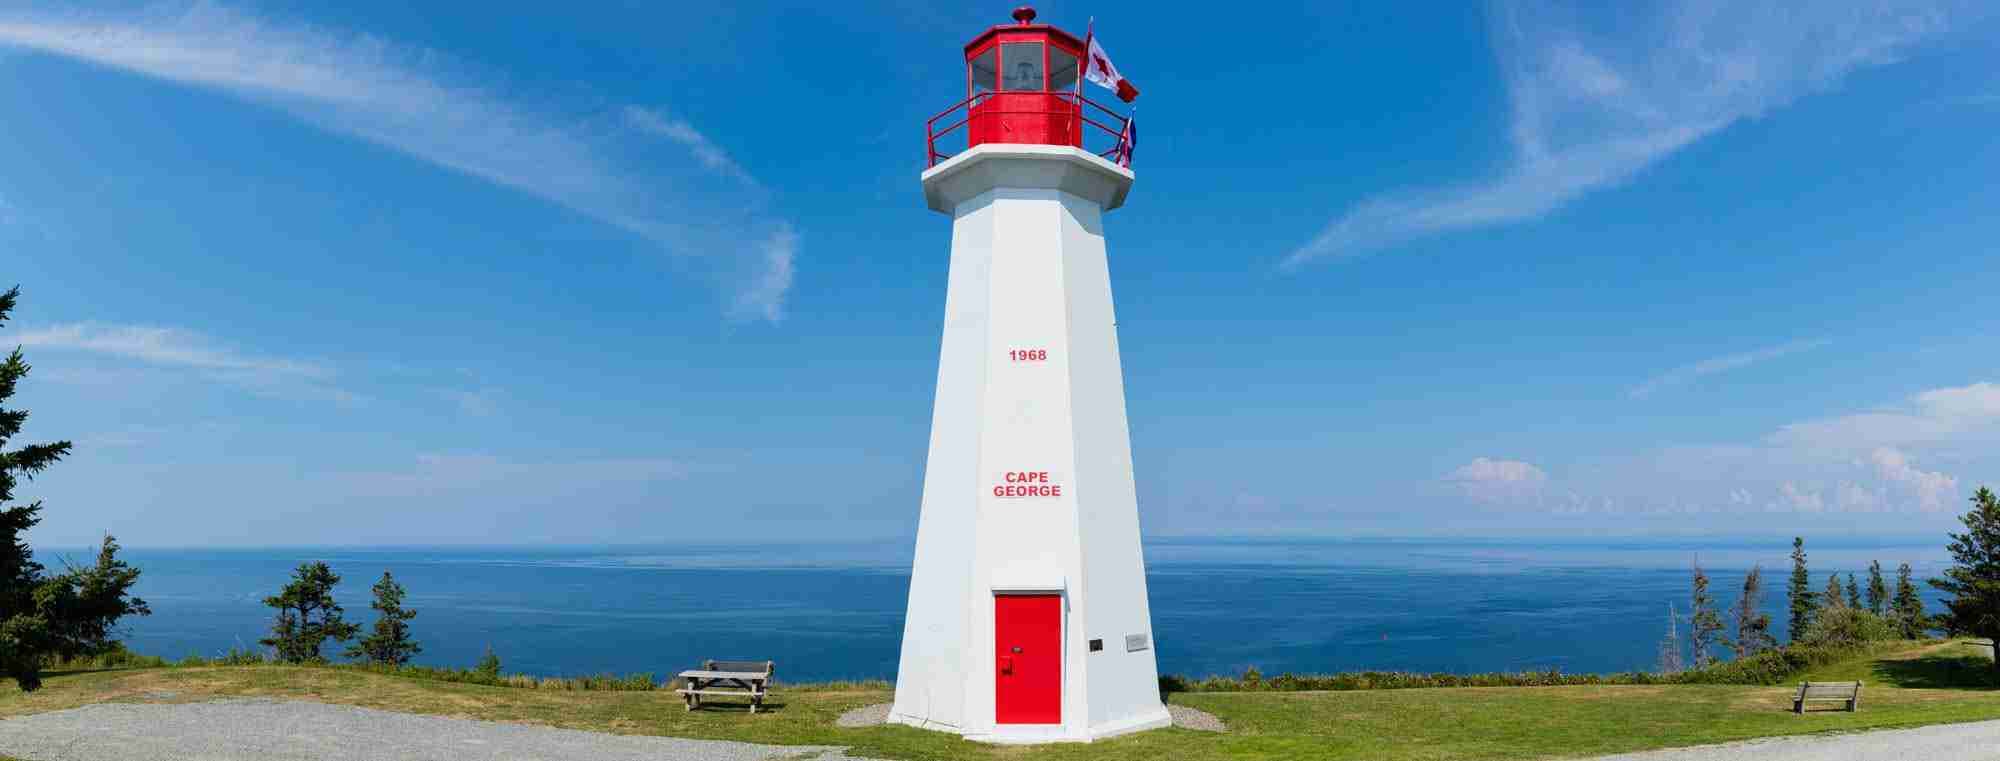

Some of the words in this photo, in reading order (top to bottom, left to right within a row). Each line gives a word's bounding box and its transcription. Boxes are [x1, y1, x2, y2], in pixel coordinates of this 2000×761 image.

[1009, 349, 1047, 361] 1968
[1005, 471, 1049, 483] CAPE
[993, 485, 1061, 497] GEORGE
